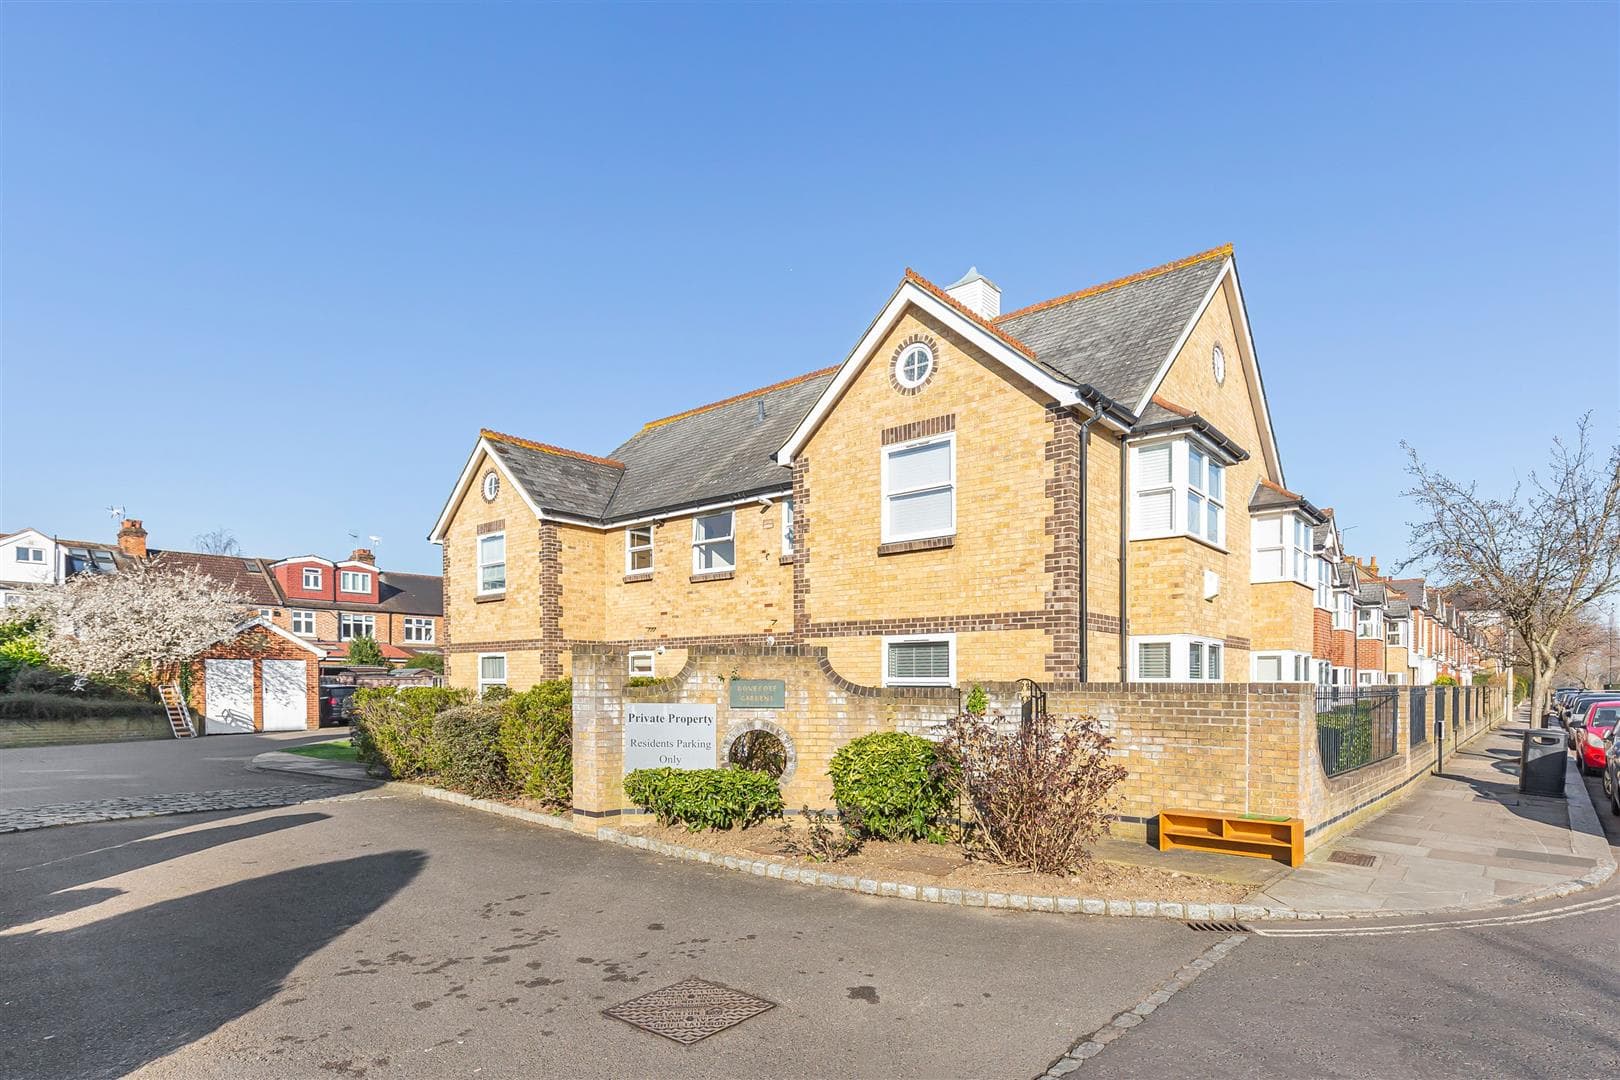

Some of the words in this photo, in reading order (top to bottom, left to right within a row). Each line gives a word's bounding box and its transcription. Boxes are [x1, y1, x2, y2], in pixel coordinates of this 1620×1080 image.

[628, 713, 665, 723] Private
[668, 713, 713, 726] Property
[630, 739, 674, 747] Residents
[676, 739, 712, 750] Parking
[659, 754, 681, 765] Only
